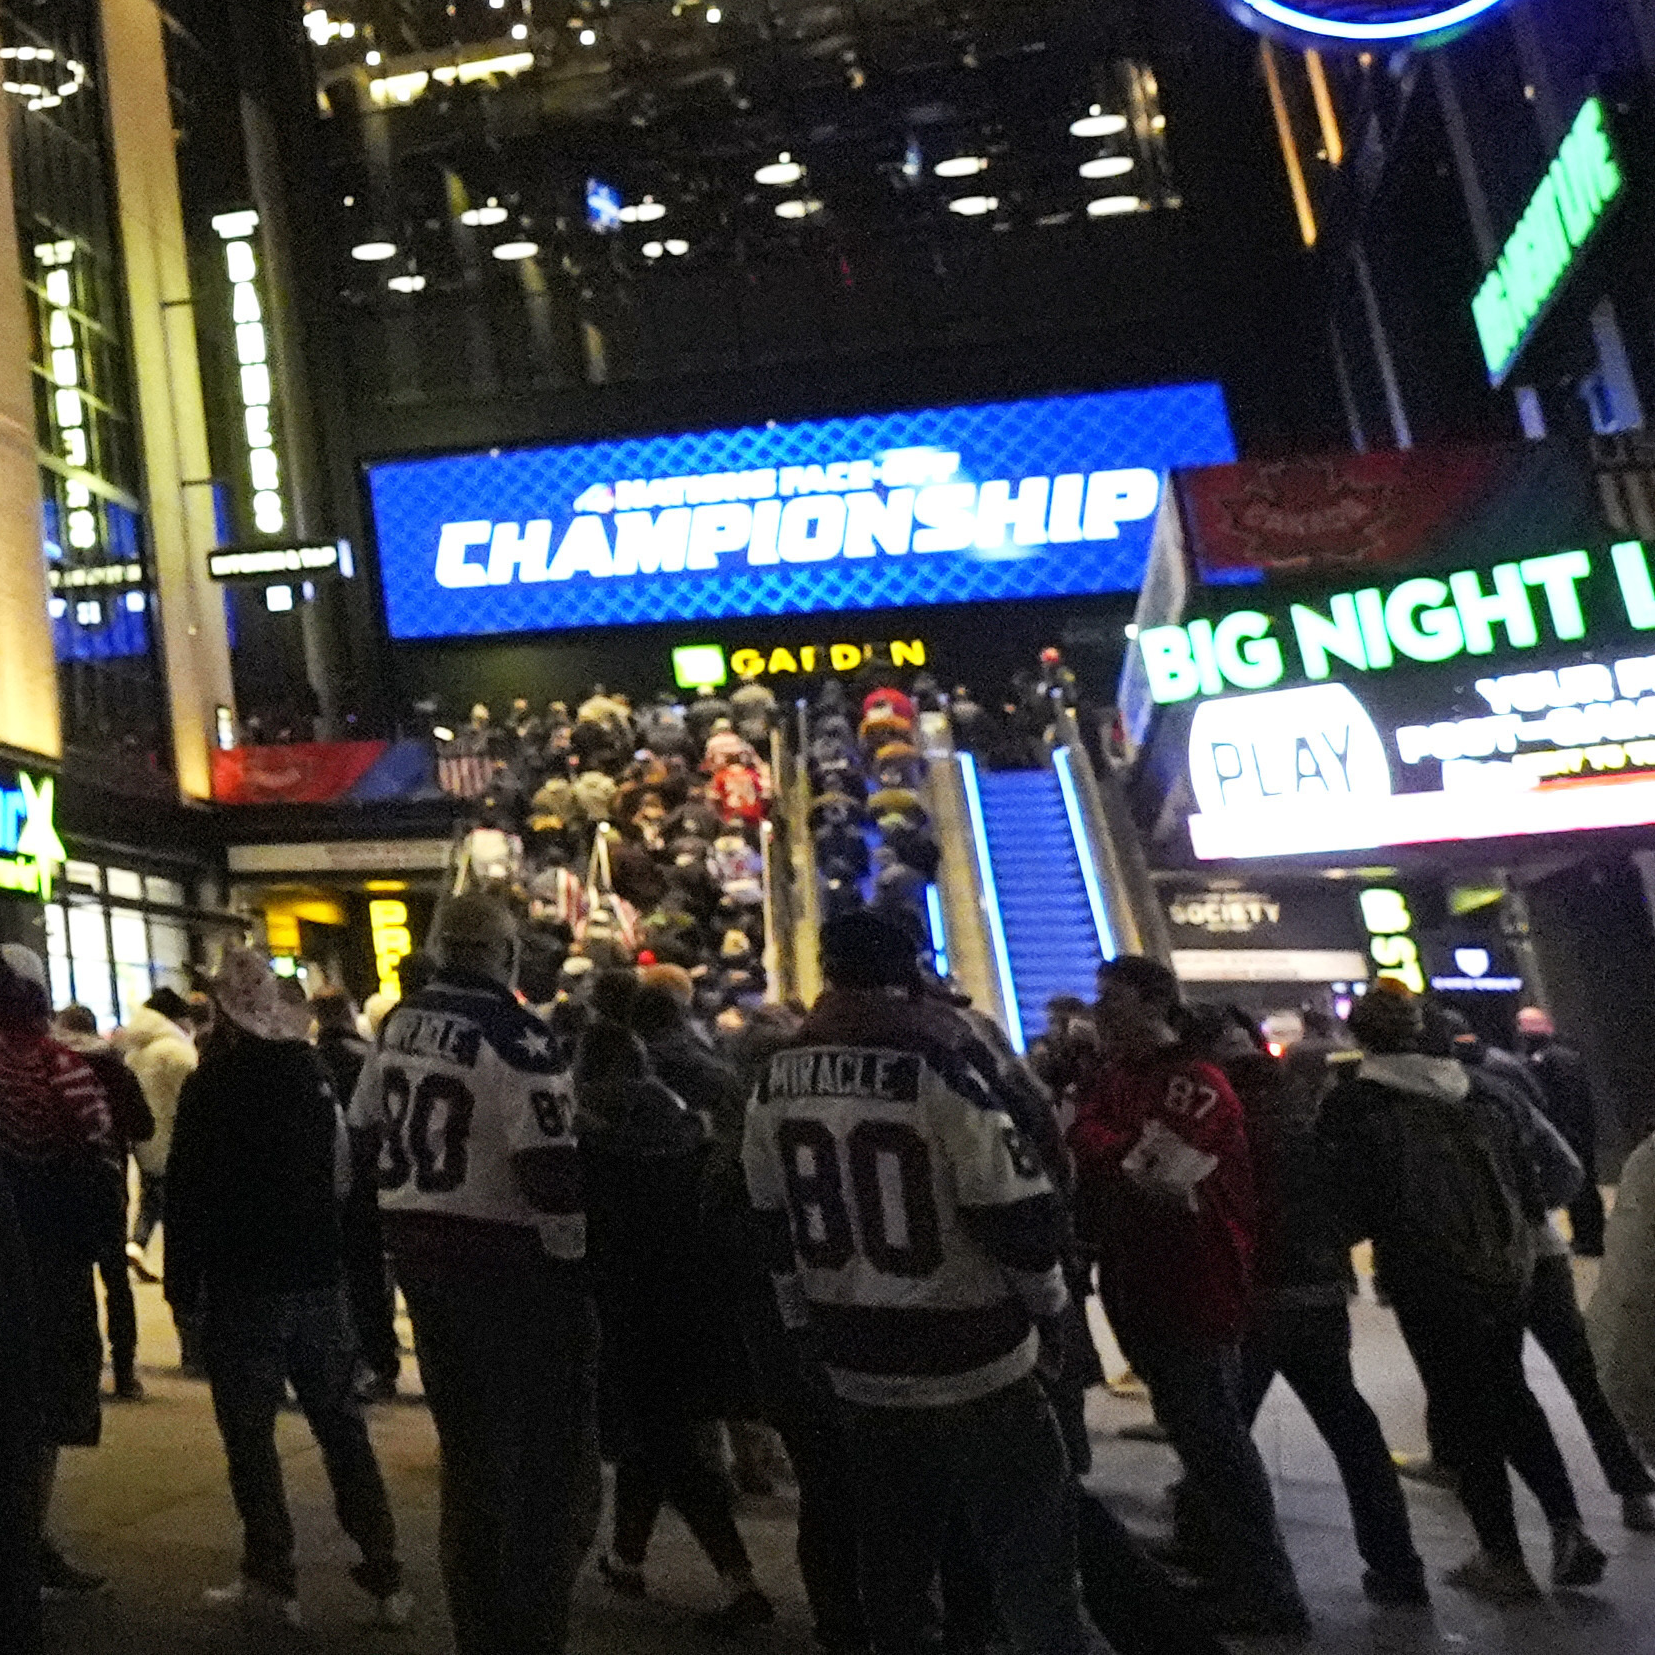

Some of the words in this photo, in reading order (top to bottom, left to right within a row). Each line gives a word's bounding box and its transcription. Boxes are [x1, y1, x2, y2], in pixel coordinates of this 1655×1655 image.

[614, 466, 778, 510] NATIONS
[434, 466, 1160, 589] CHAMPIONSHIP
[1138, 609, 1285, 704] BIG
[1290, 549, 1592, 682] NIGHT
[1168, 902, 1282, 926] SOCIETY
[770, 1050, 893, 1097] MIRACLE
[1165, 1074, 1221, 1120] 87
[778, 1117, 946, 1279] 80
